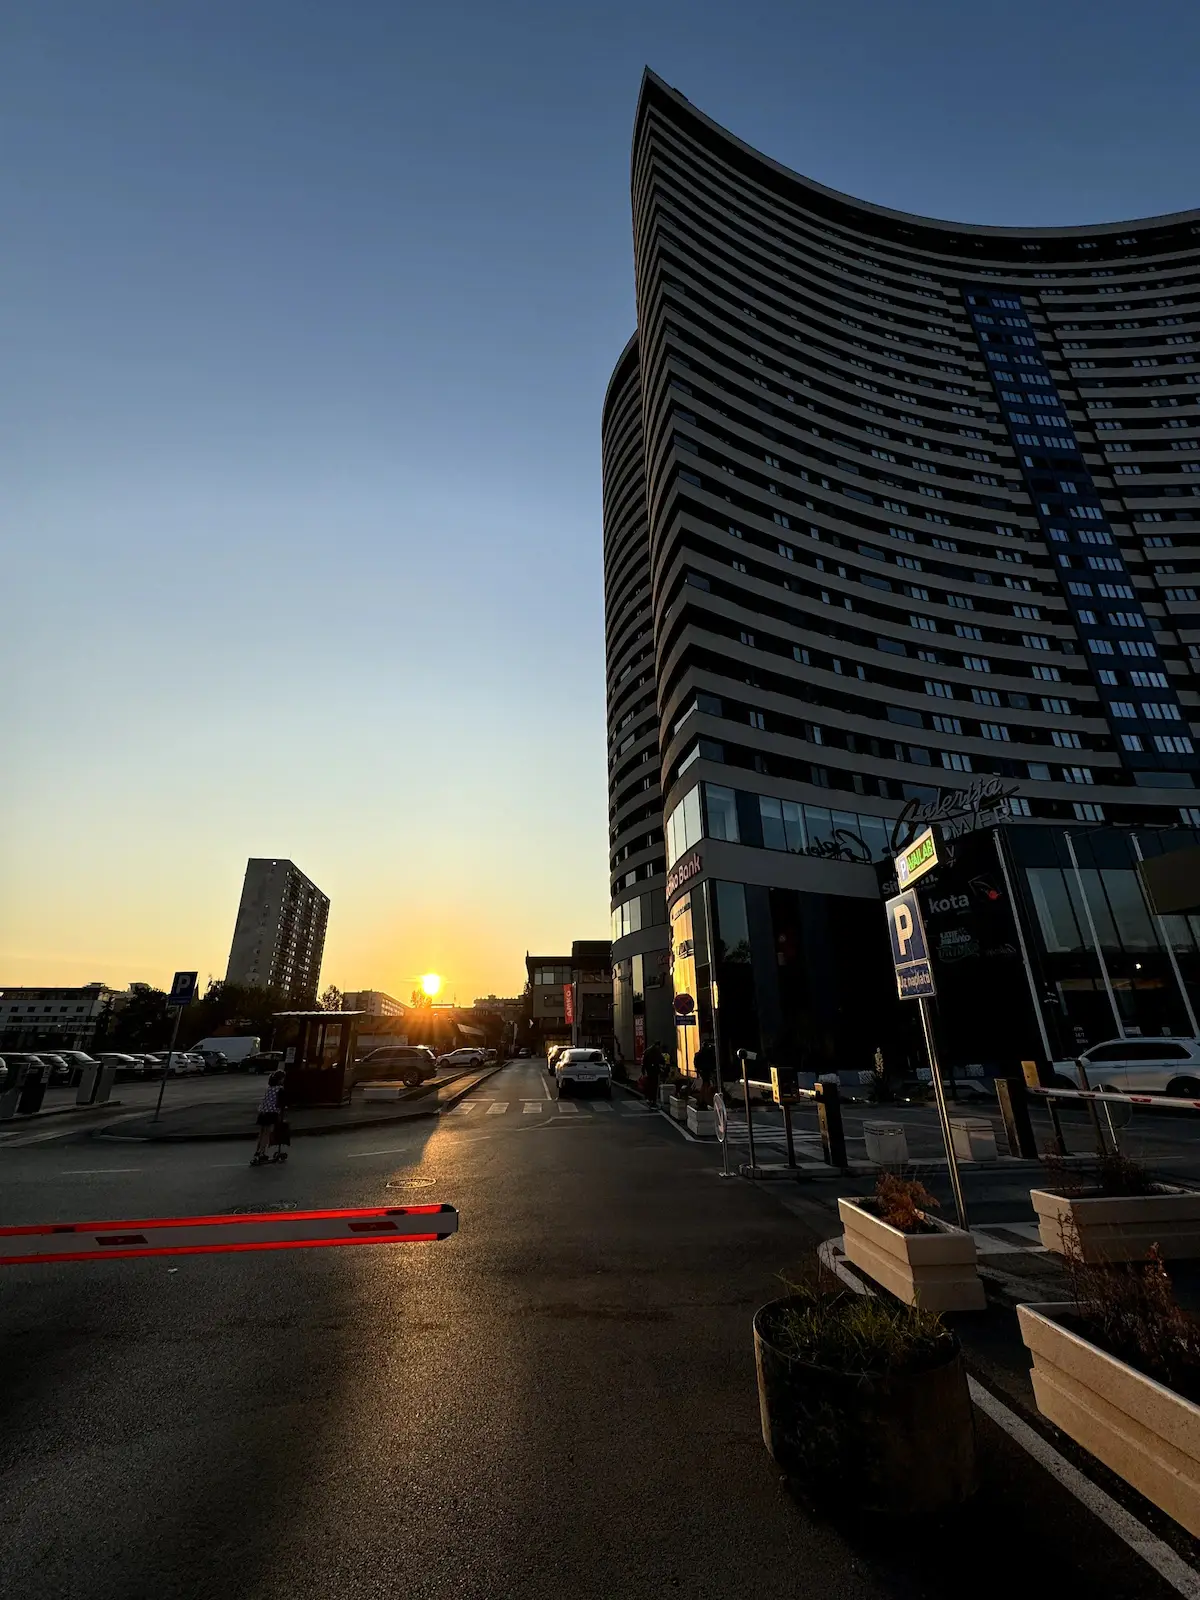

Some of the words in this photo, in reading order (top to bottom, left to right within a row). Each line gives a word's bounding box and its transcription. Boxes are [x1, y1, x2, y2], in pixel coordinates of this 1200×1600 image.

[941, 803, 1014, 842] OWER
[679, 852, 701, 885] Bank
[928, 894, 970, 914] kota
[893, 903, 914, 956] P
[176, 975, 191, 994] P
